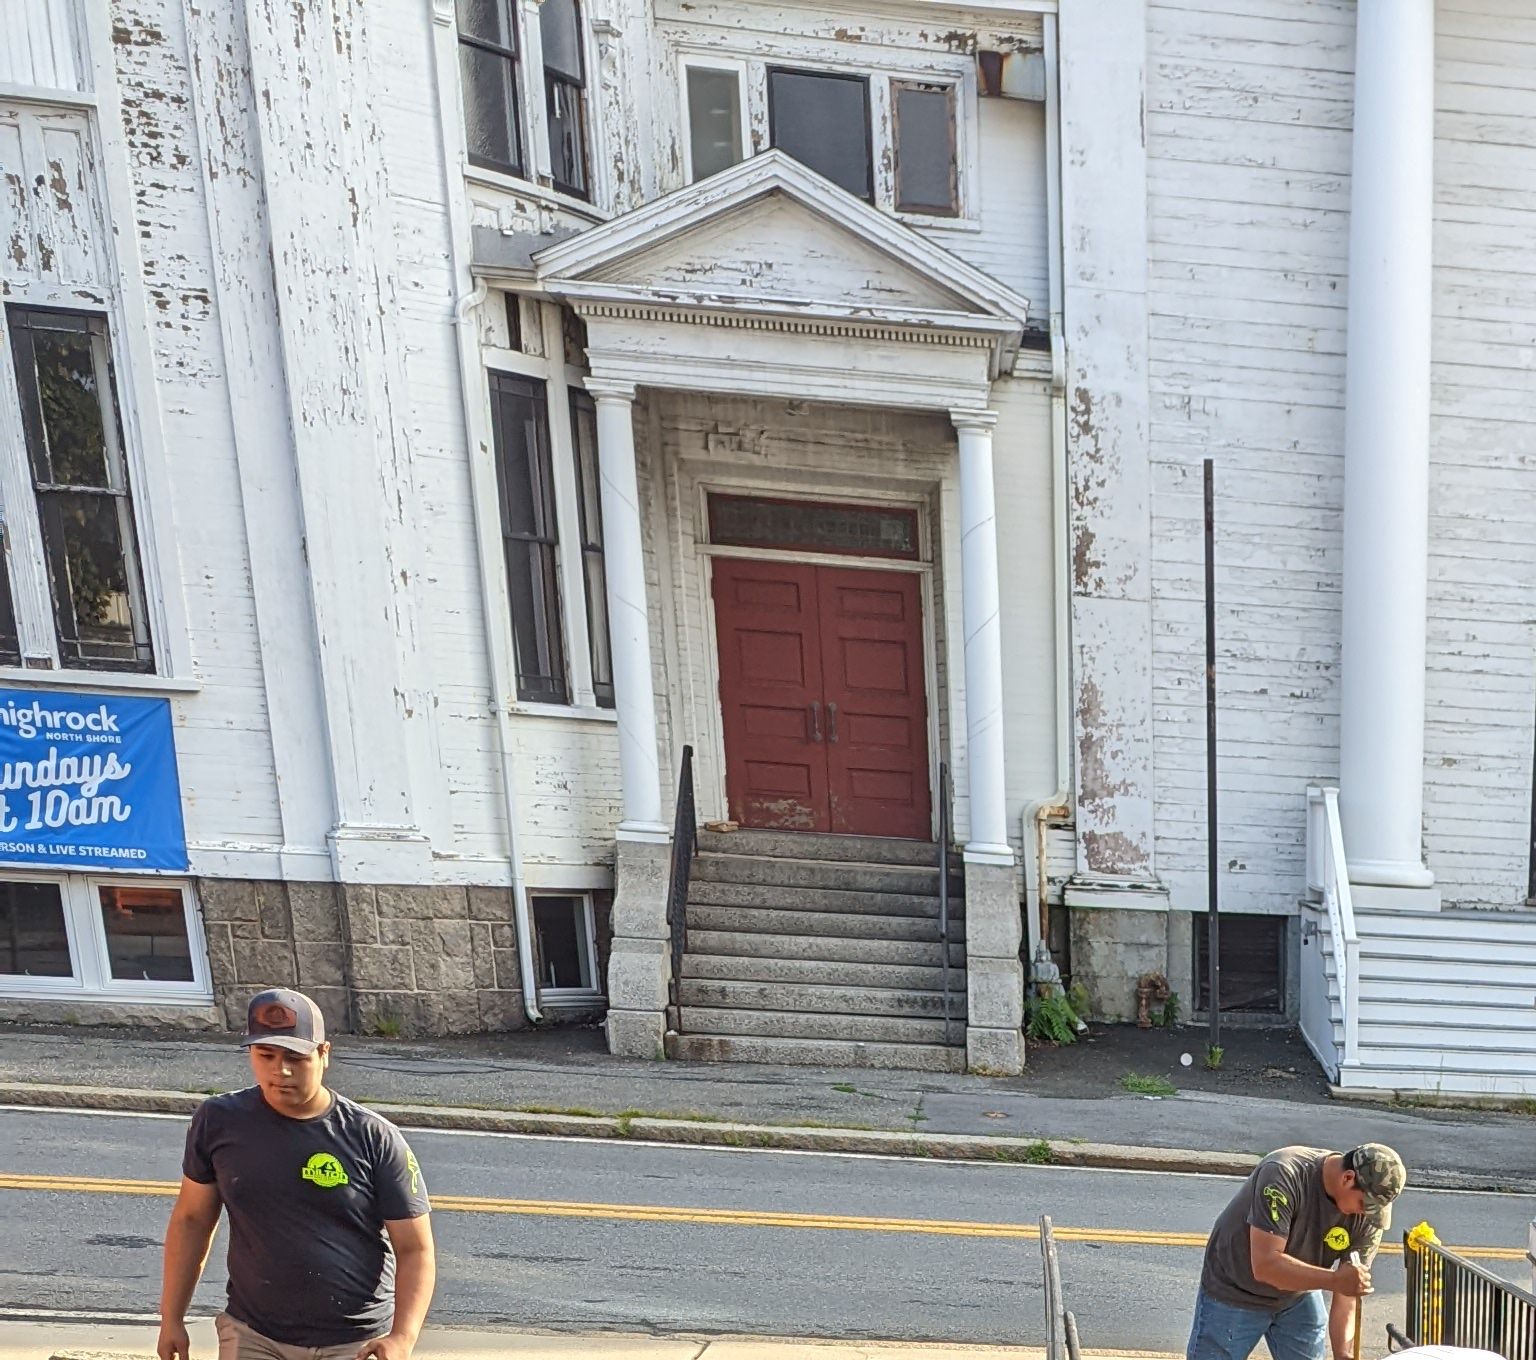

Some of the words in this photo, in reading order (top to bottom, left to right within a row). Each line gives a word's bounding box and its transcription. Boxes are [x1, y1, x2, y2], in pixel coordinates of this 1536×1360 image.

[46, 732, 83, 742] NORTH
[86, 735, 122, 744] SHORE
[25, 789, 131, 830] 10am
[38, 843, 47, 854] &
[49, 845, 76, 856] LIVE
[79, 846, 147, 859] STREAMED
